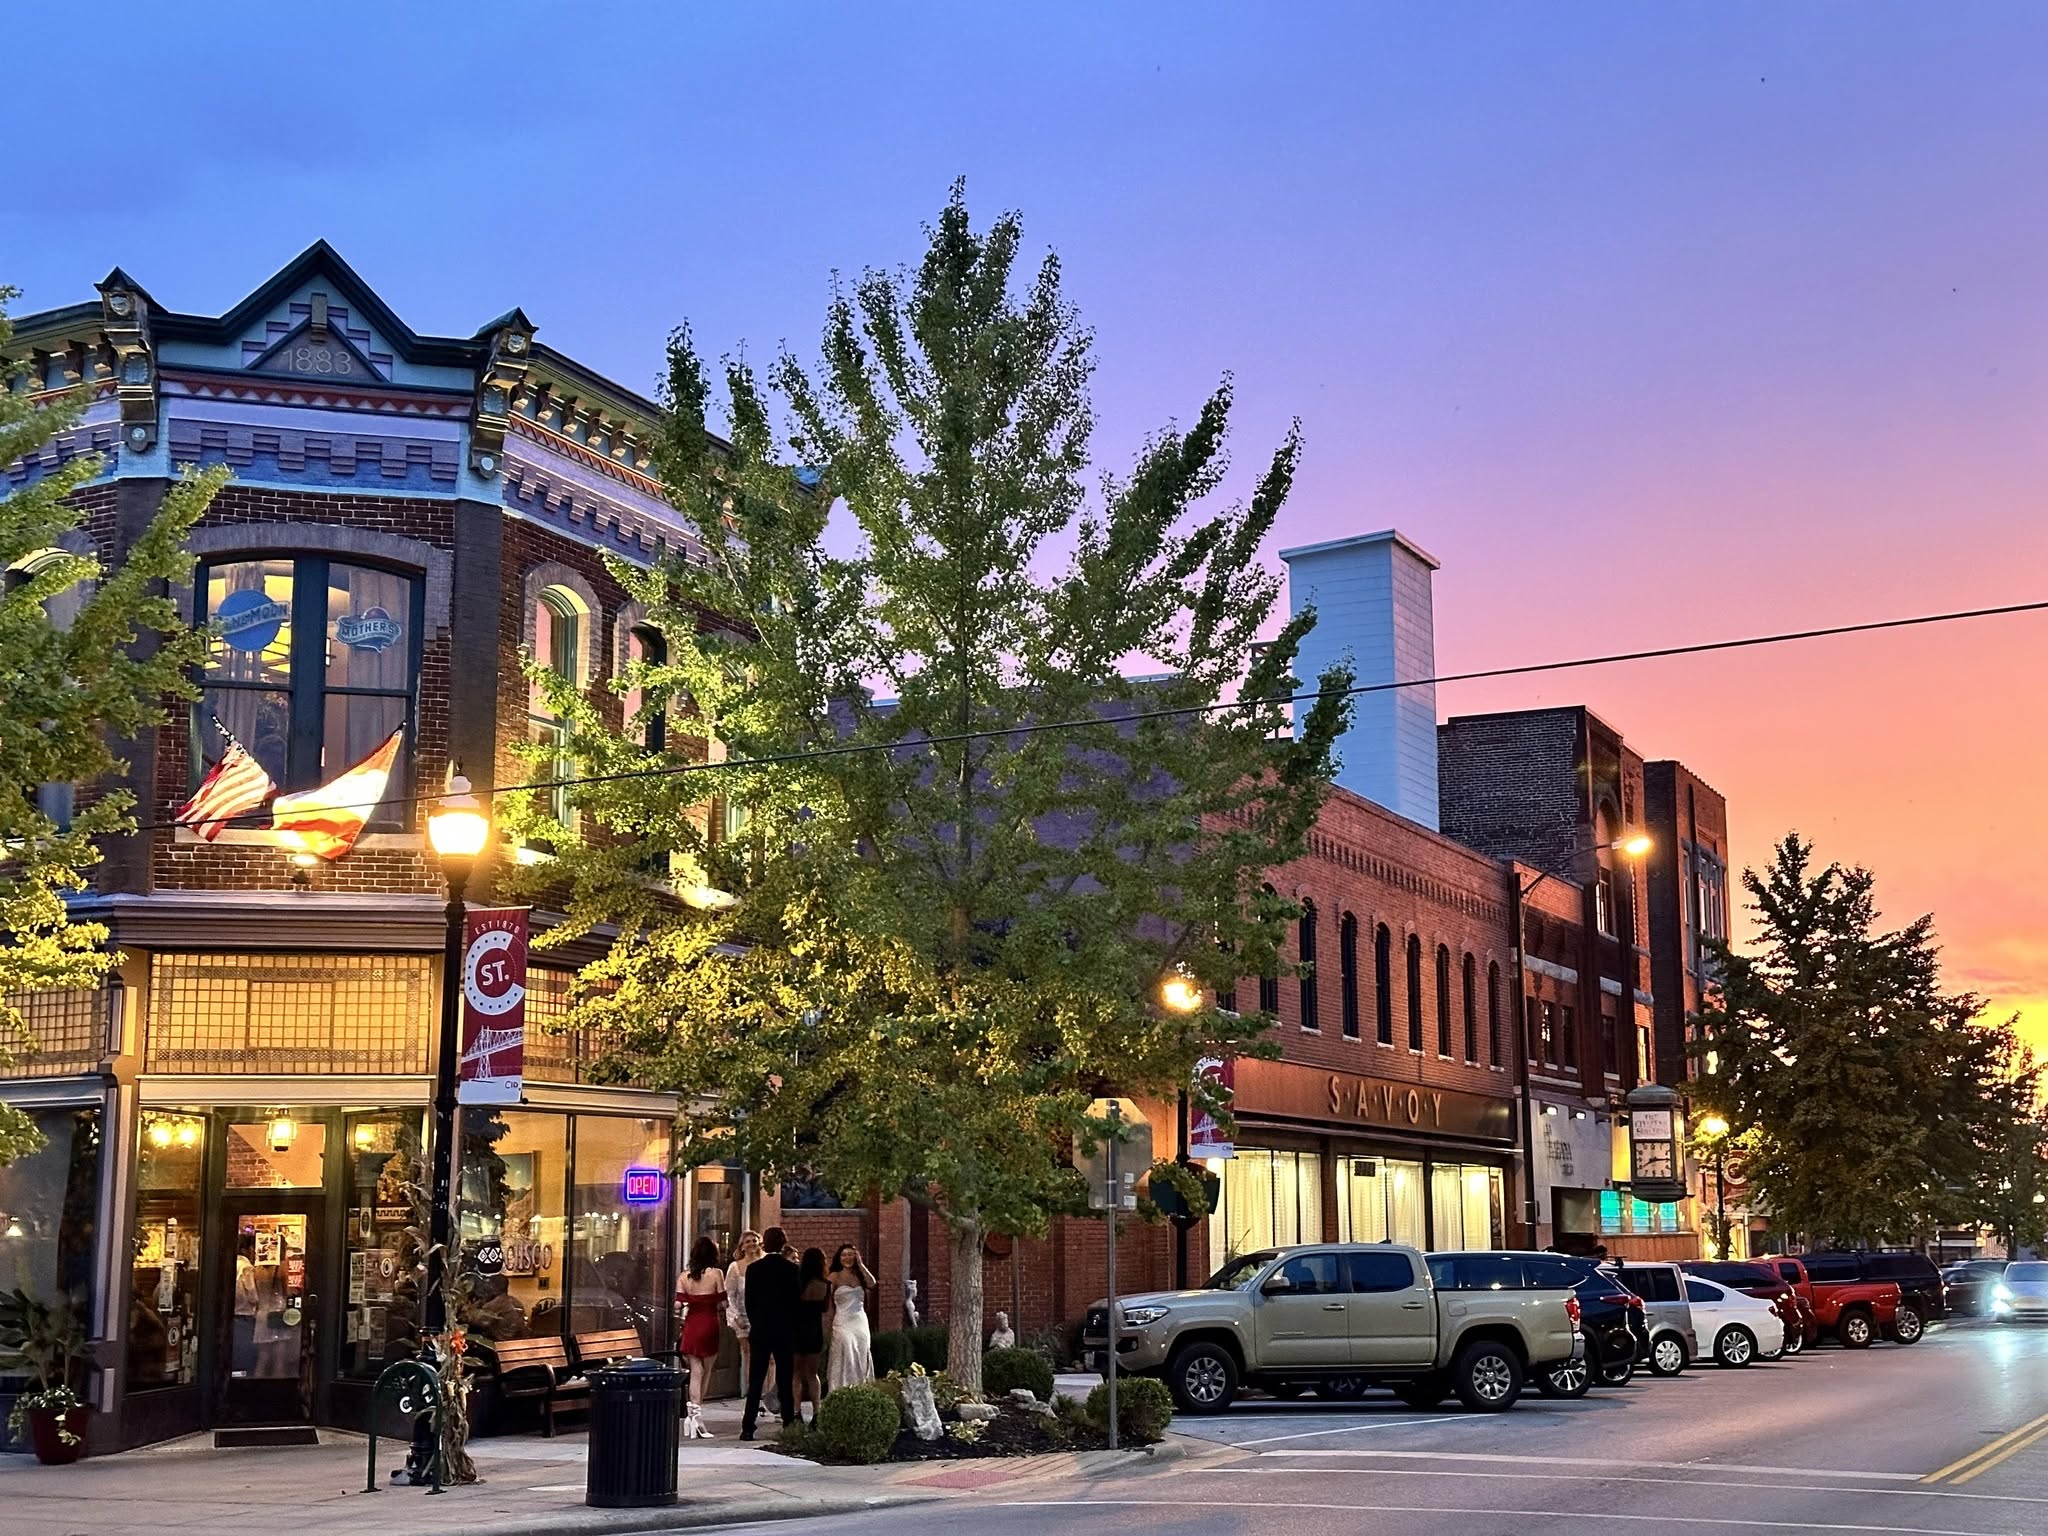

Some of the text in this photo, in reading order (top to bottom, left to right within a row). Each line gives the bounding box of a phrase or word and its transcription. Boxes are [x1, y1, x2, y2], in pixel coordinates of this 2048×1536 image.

[282, 348, 351, 374] 1883
[250, 603, 288, 623] MOON
[474, 920, 493, 935] EST
[481, 960, 510, 986] ST.
[629, 1175, 658, 1196] OPEN
